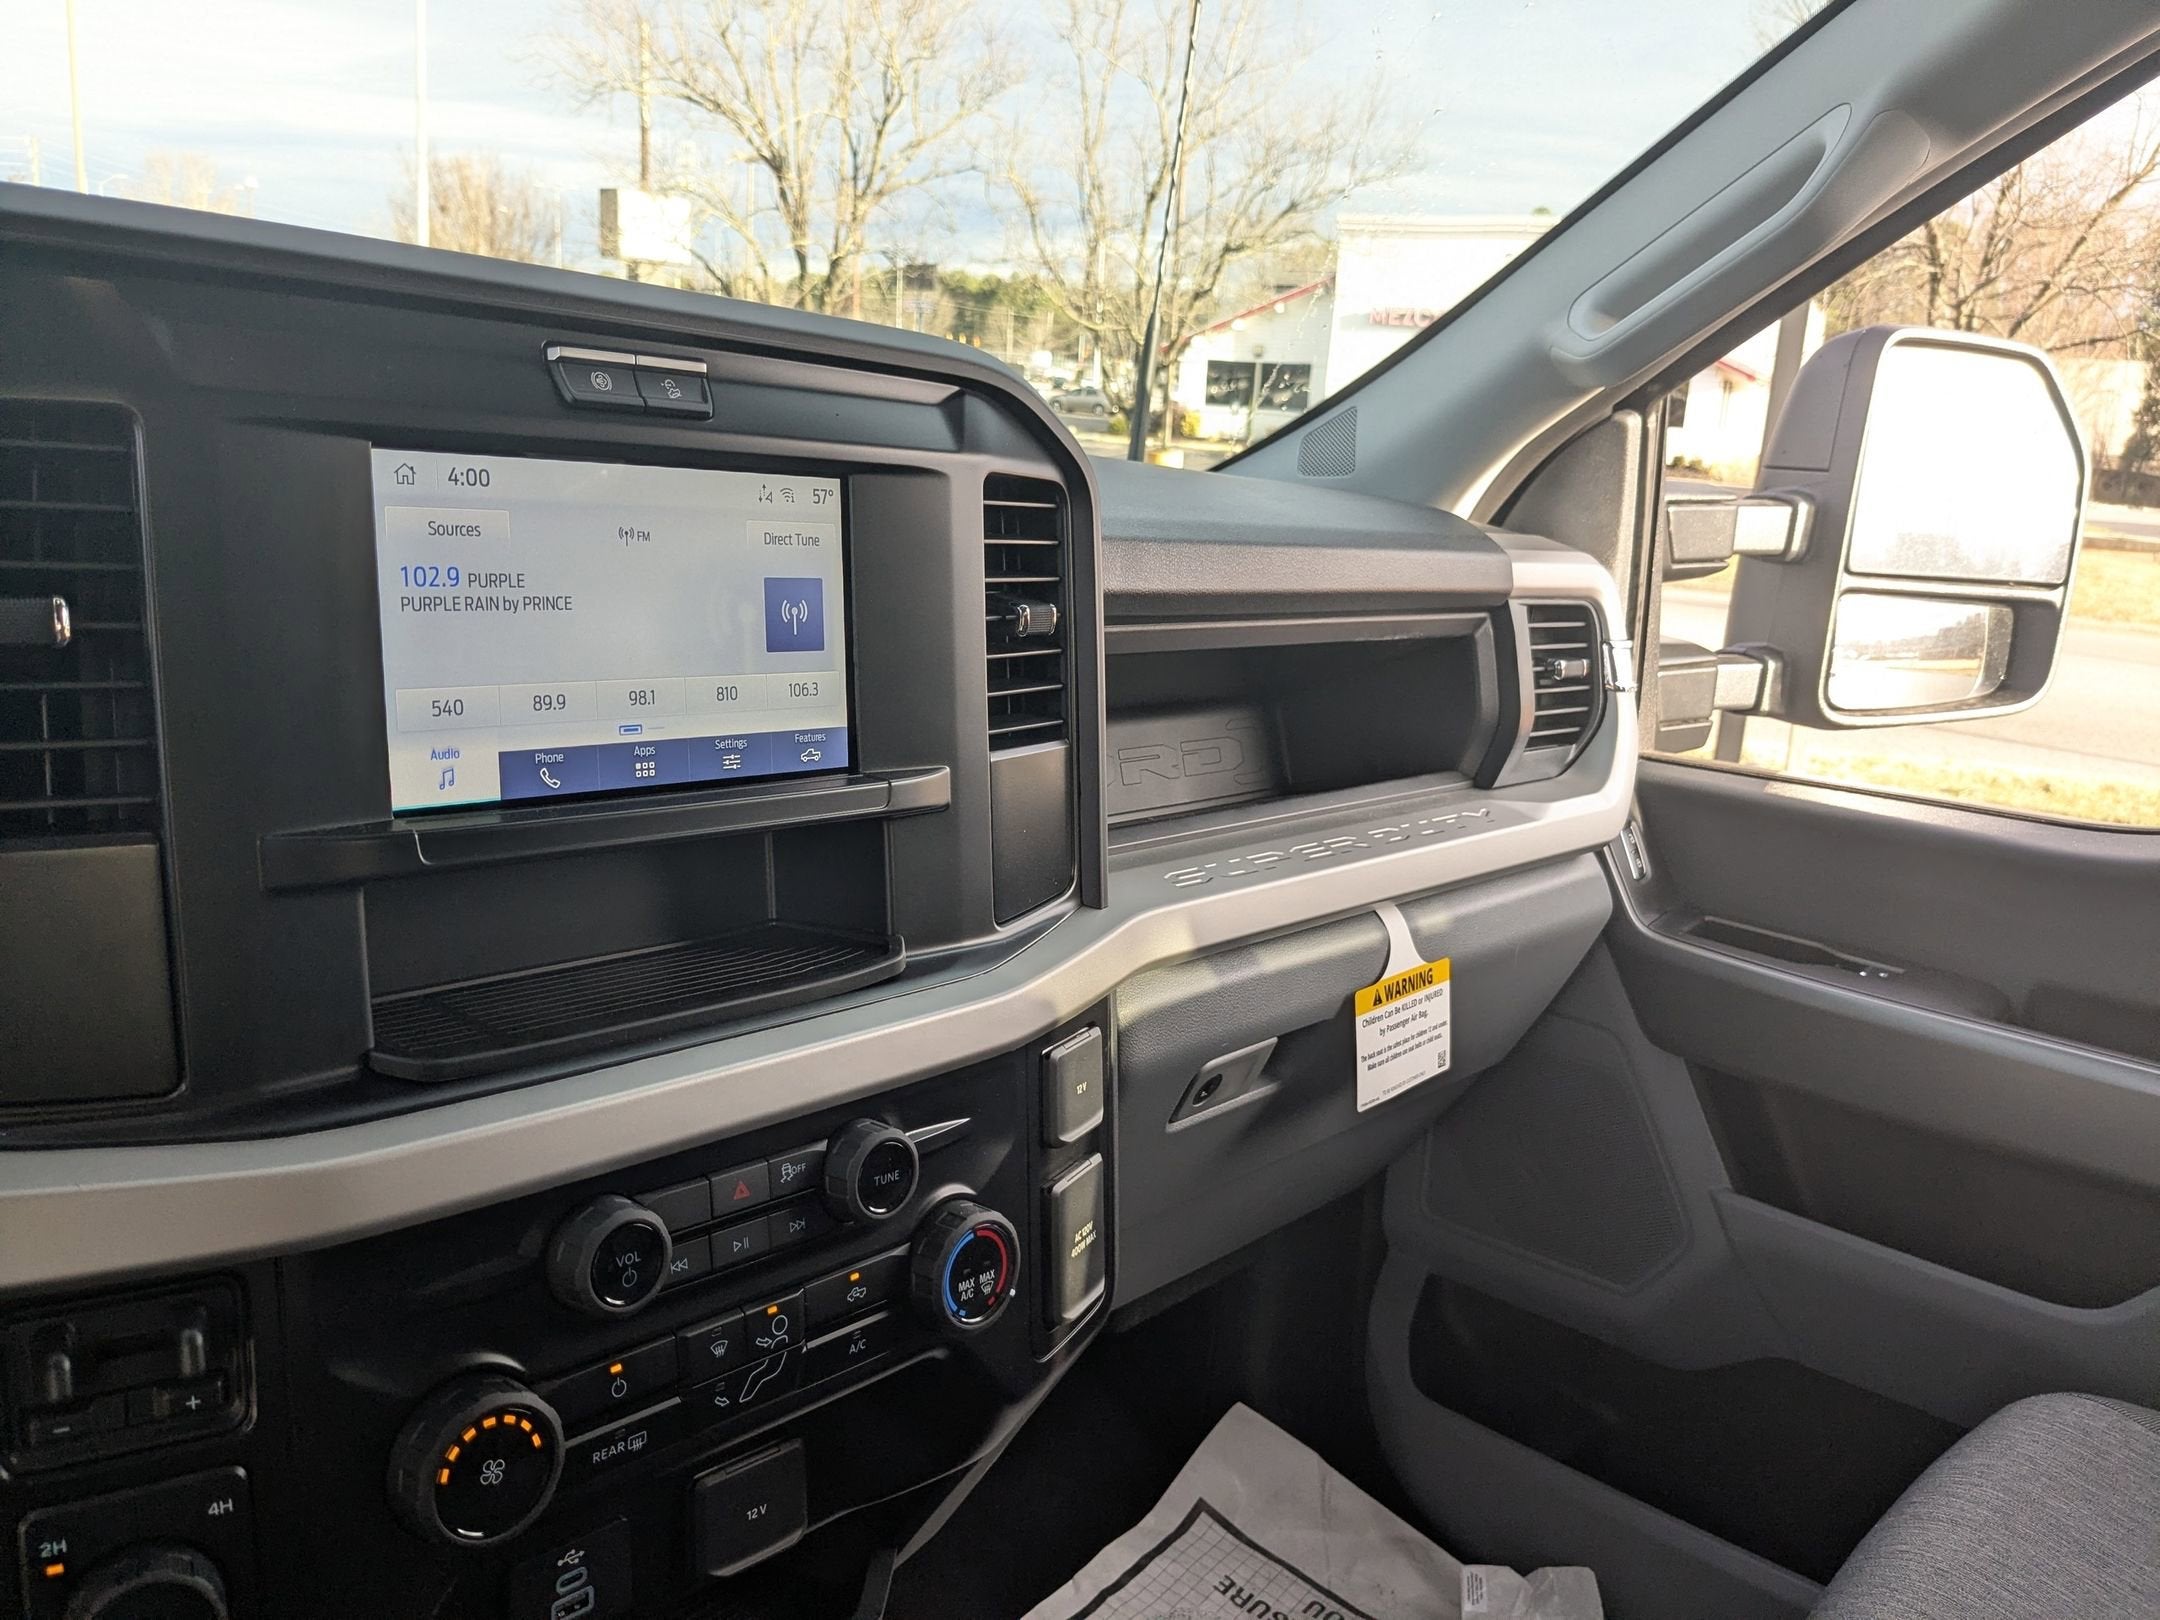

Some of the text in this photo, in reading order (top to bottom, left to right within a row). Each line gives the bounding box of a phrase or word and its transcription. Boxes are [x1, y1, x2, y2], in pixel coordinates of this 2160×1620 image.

[1369, 307, 1447, 327] MEZC
[447, 467, 490, 487] 4:00
[427, 520, 481, 538] Sources
[637, 530, 651, 543] FM
[763, 531, 820, 547] Direct Tune
[400, 566, 525, 589] 102.9 PURPLE
[401, 596, 572, 614] PURPLE RAIN by PRINCE
[431, 682, 819, 718] 540 89.9 98.1 810 106.3
[715, 738, 748, 751] Settings
[794, 731, 826, 744] Features
[430, 747, 460, 761] Audio
[535, 751, 564, 764] Phone
[633, 744, 656, 758] Apps
[1163, 836, 1372, 888] SUPER
[1384, 968, 1433, 1002] WARNING
[1362, 1014, 1384, 1028] Children
[1384, 1009, 1393, 1019] Can
[1395, 1006, 1400, 1015] Be
[1402, 998, 1417, 1011] KILLED
[1424, 988, 1443, 1003] INJURED
[1379, 1027, 1386, 1037] by
[1387, 1015, 1410, 1033] Passenger
[1076, 1081, 1088, 1095] 12V
[792, 1163, 806, 1174] OFF
[874, 1170, 900, 1186] TUNE
[1075, 1220, 1093, 1244] AC 120V
[1071, 1229, 1097, 1259] 400W MAX
[616, 1251, 641, 1267] VOL
[959, 1277, 975, 1293] MAX
[980, 1269, 995, 1284] MAX
[961, 1288, 974, 1301] A/C
[849, 1339, 866, 1355] A/C
[593, 1441, 625, 1463] REAR
[208, 1498, 233, 1517] 4H
[38, 1539, 68, 1558] 2H
